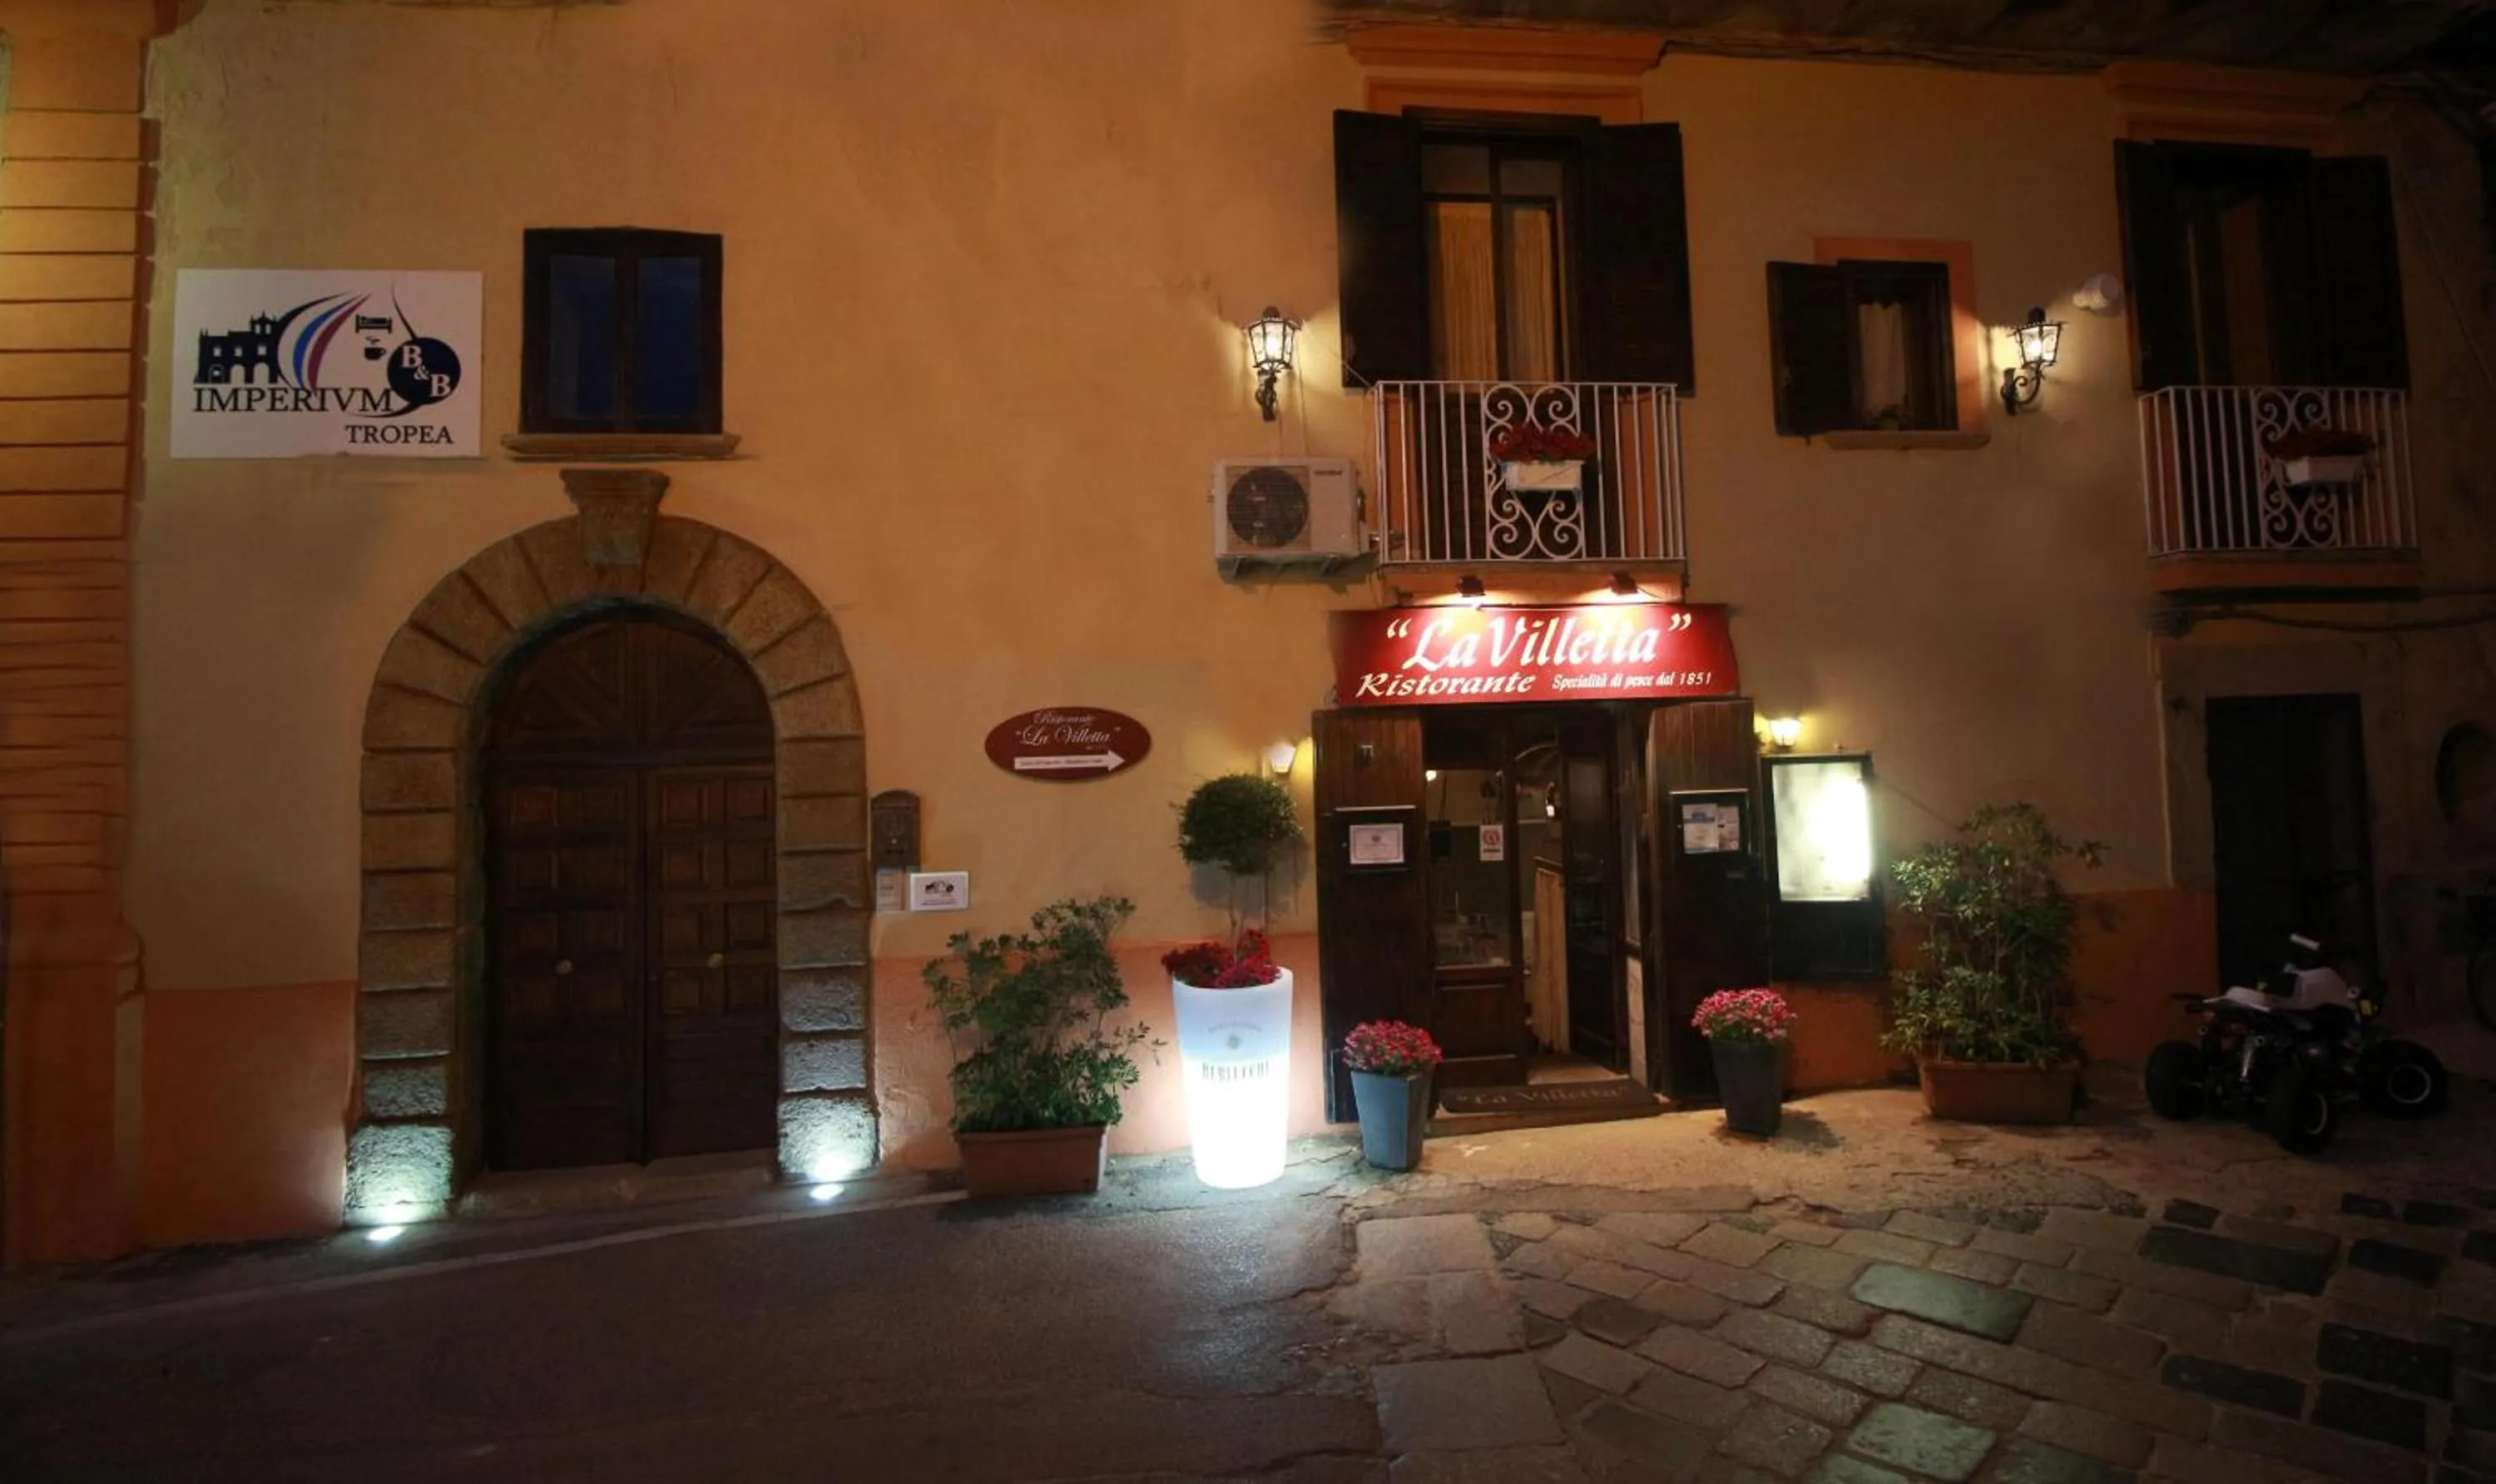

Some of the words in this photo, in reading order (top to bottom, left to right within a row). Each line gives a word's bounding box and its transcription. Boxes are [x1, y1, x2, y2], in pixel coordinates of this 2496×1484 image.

[192, 387, 394, 413] IMPERIVM
[345, 425, 453, 445] TROPEA
[1355, 671, 1538, 698] Ristorante
[1610, 672, 1623, 687] di
[1624, 675, 1654, 690] pesce
[1656, 671, 1676, 686] dal
[1678, 671, 1712, 686] 1851
